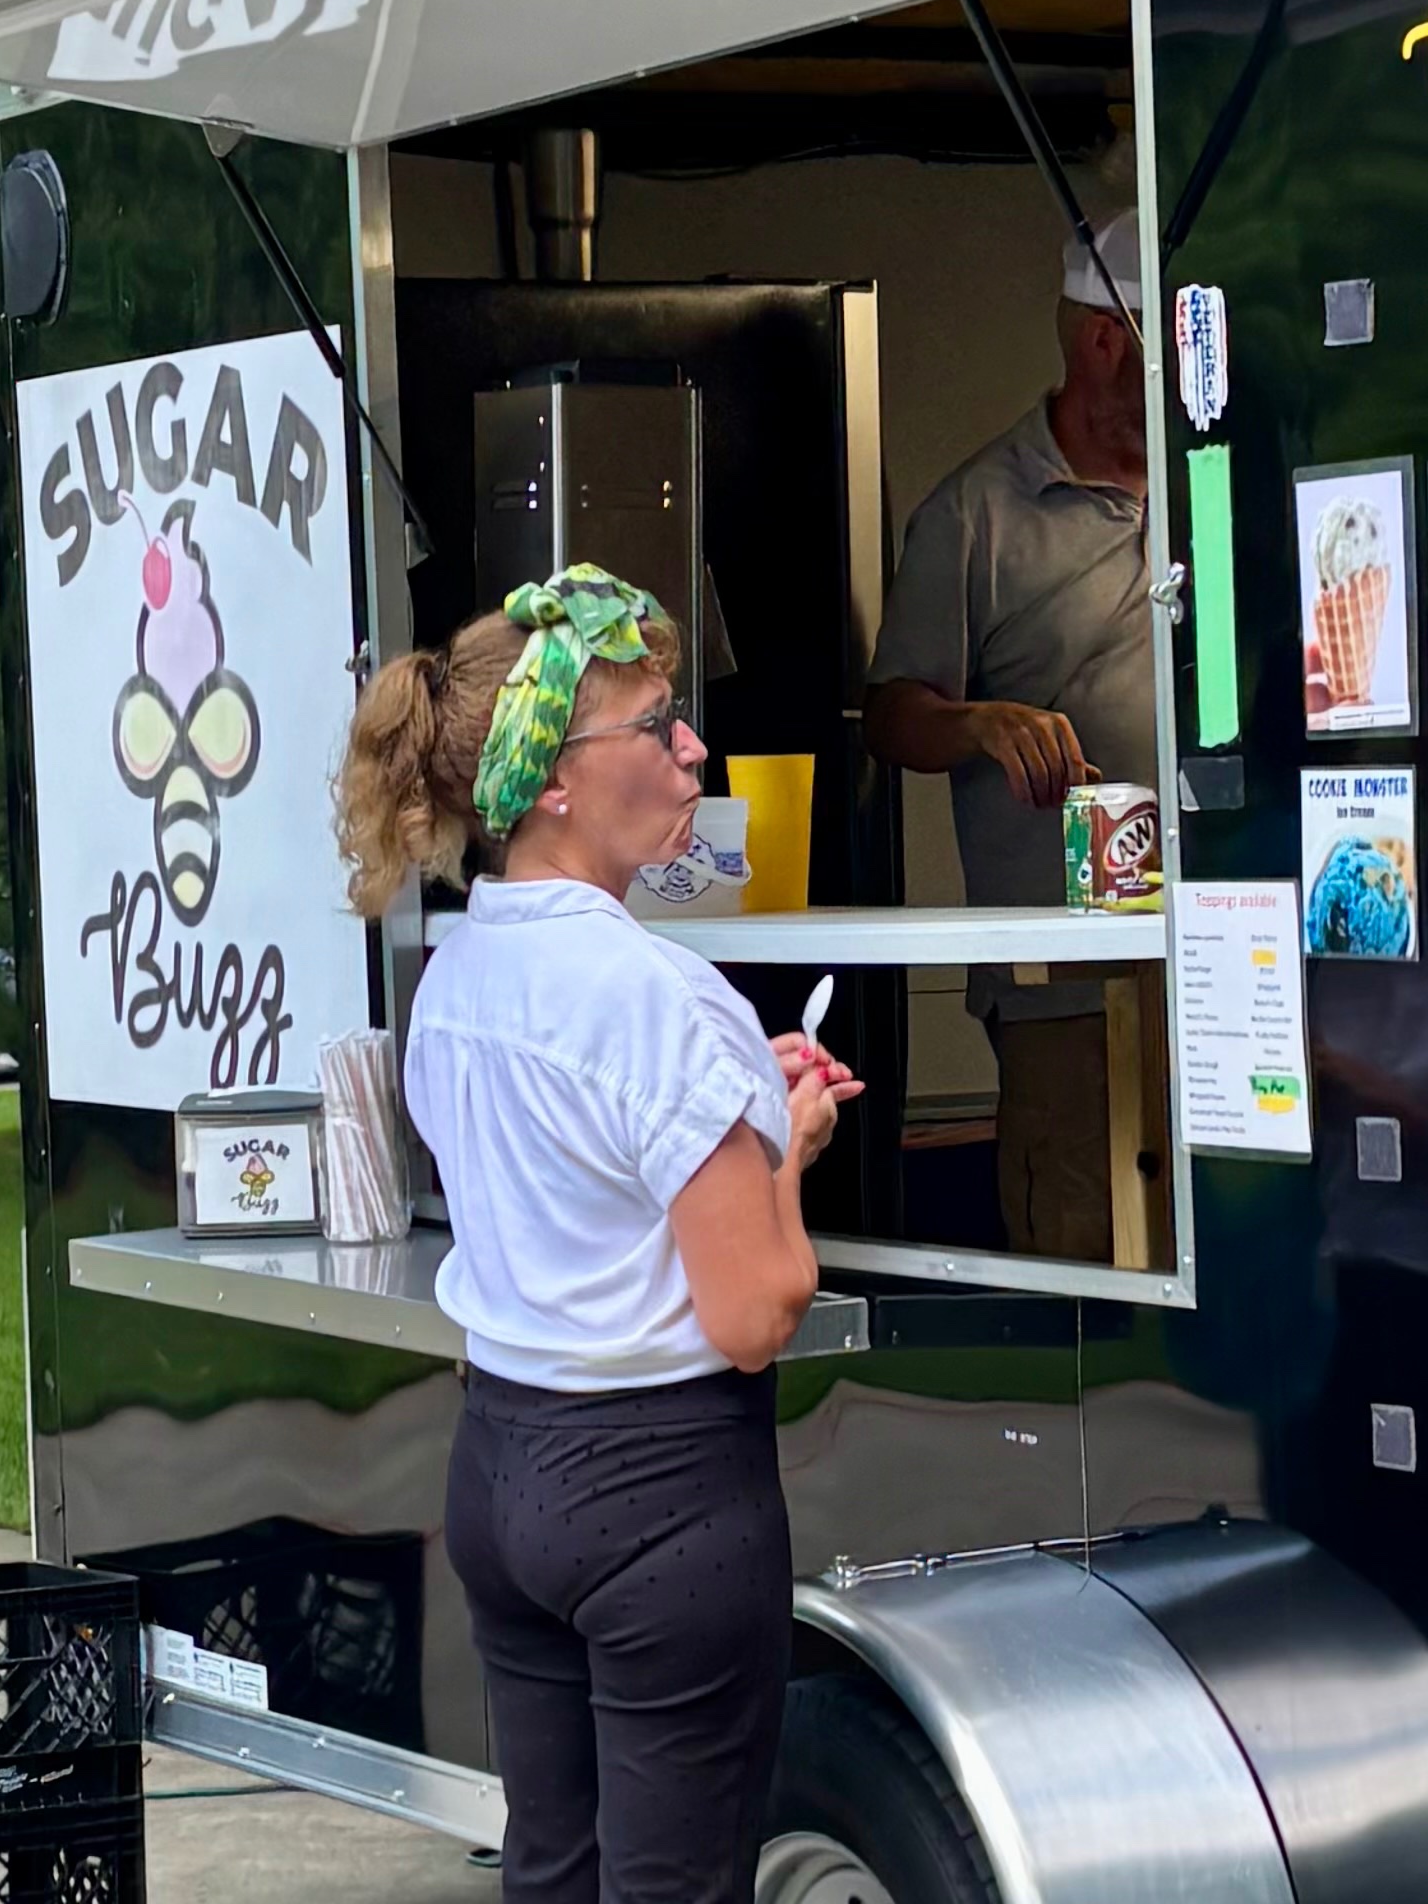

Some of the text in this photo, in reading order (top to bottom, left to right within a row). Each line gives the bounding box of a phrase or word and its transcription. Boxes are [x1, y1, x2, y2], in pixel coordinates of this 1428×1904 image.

[39, 361, 328, 588] SUGAR
[1354, 776, 1408, 797] MONSTER
[80, 870, 293, 1089] Buzz
[223, 1138, 290, 1163] SUGAR
